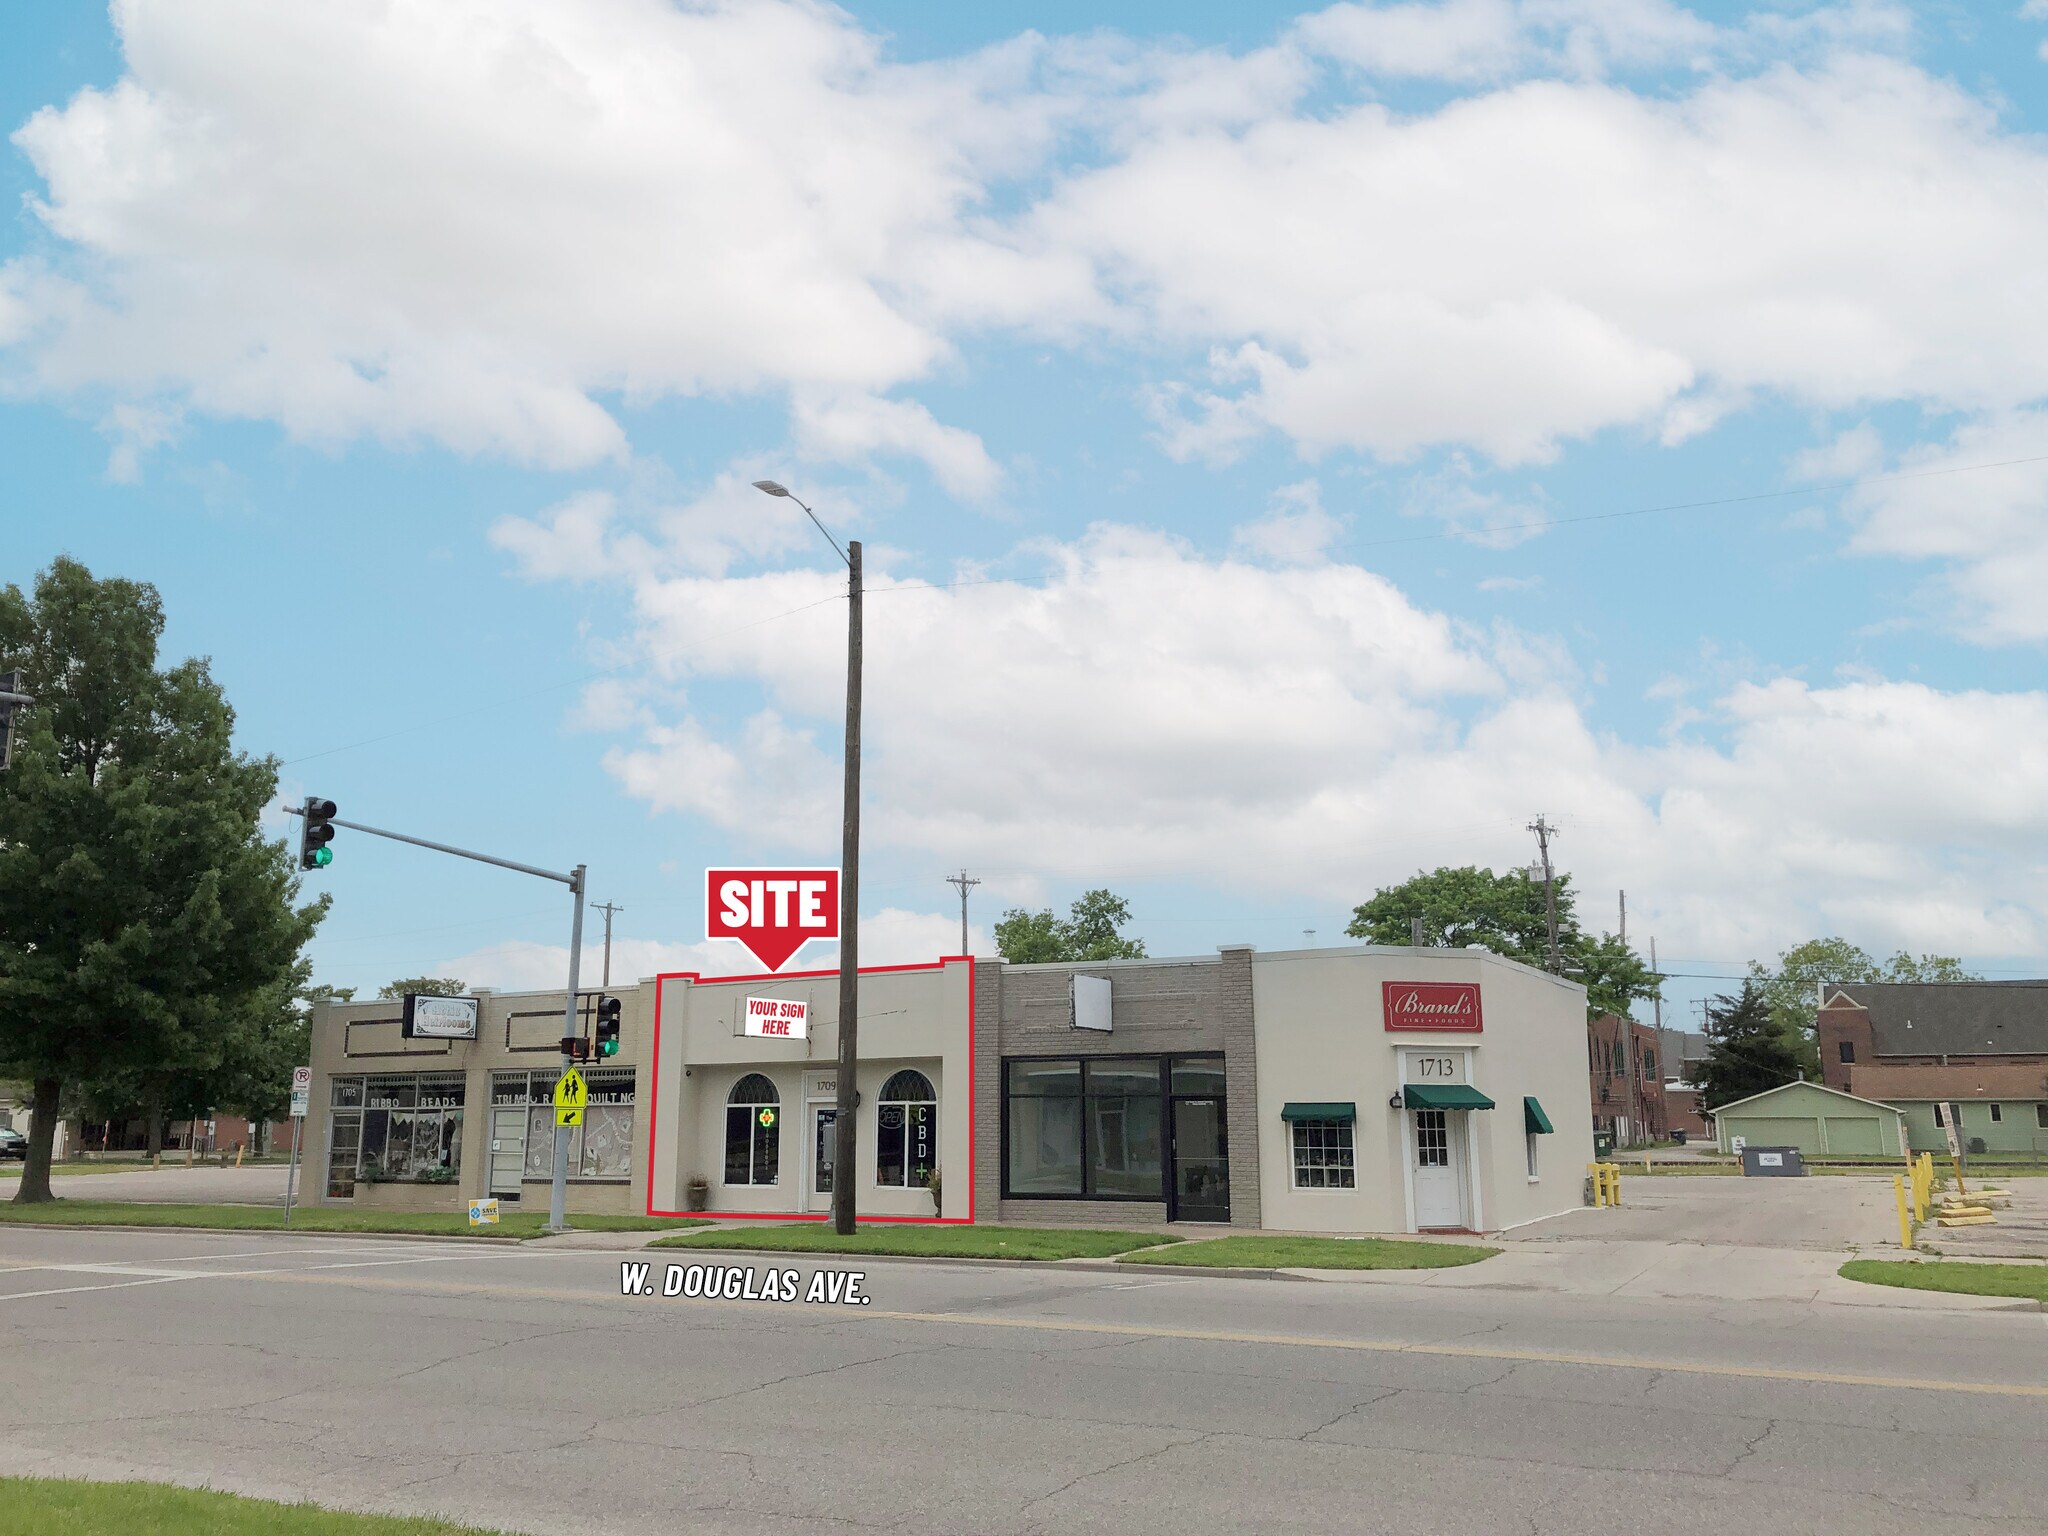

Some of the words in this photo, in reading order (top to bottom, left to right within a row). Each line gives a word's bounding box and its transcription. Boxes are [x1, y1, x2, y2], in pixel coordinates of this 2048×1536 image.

[1395, 989, 1471, 1014] Brand's
[1418, 1059, 1453, 1076] 1713
[817, 1081, 836, 1090] 1709
[342, 1088, 356, 1097] 1705
[421, 1097, 456, 1107] BEADS
[880, 1111, 904, 1122] OPEN
[918, 1107, 926, 1157] CBD
